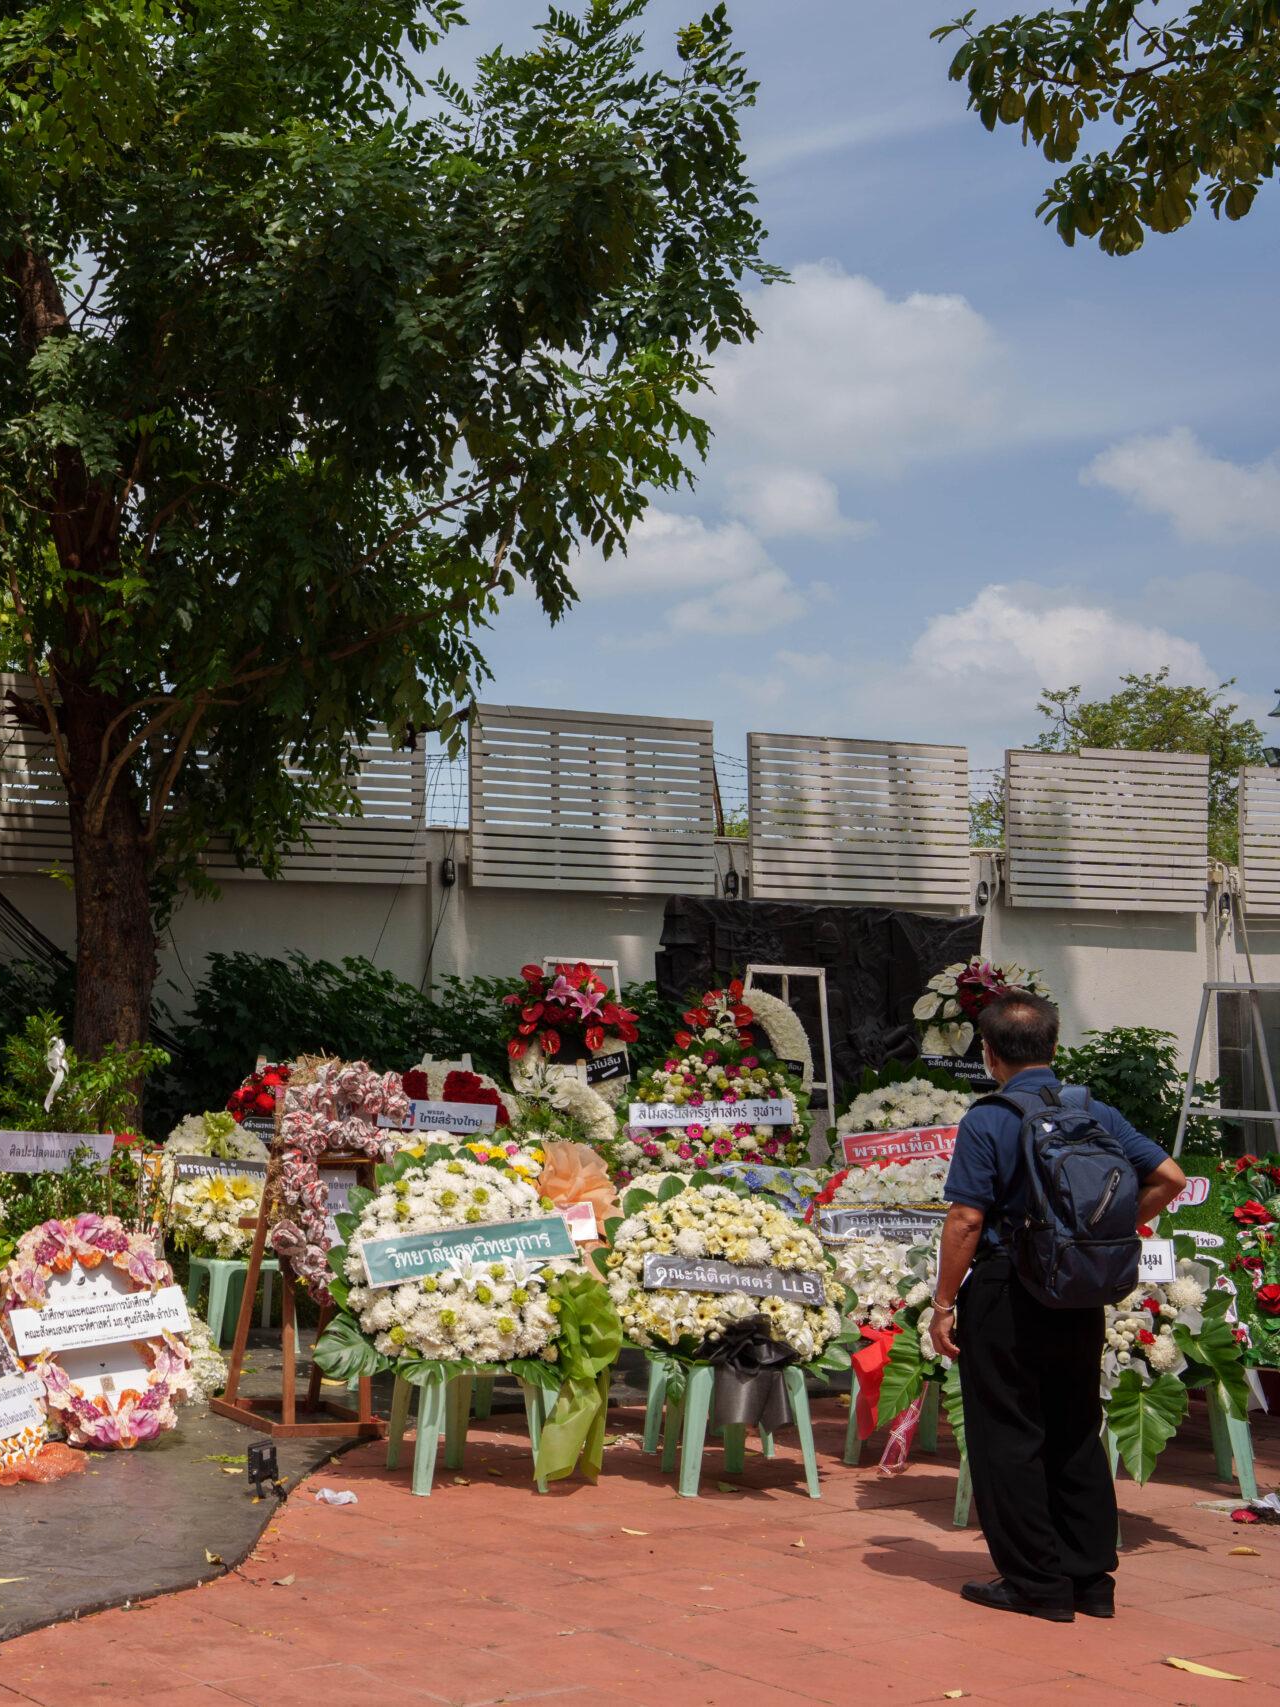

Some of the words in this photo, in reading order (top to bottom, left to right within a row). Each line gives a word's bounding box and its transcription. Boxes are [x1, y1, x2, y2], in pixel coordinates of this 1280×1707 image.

[587, 1056, 621, 1071] ราไม่ลืม
[420, 1113, 483, 1127] ไทยสร้างไทย
[753, 1106, 783, 1122] จุฬาฯ
[9, 1144, 66, 1159] ศิลปะปลดแอก
[852, 1132, 957, 1158] พรรคเพื่อไท
[385, 1232, 551, 1268] วิทยาลัยสหวิทยาการ
[1139, 1254, 1162, 1270] นุม
[656, 1266, 773, 1289] คณะนิติศาสตร์
[782, 1279, 815, 1294] LLB
[39, 1296, 154, 1321] นักศึกษาและคณะกรรมการนักศึกษา
[25, 1315, 112, 1339] คณะสังคมสงเคราะห์ศาสตร์
